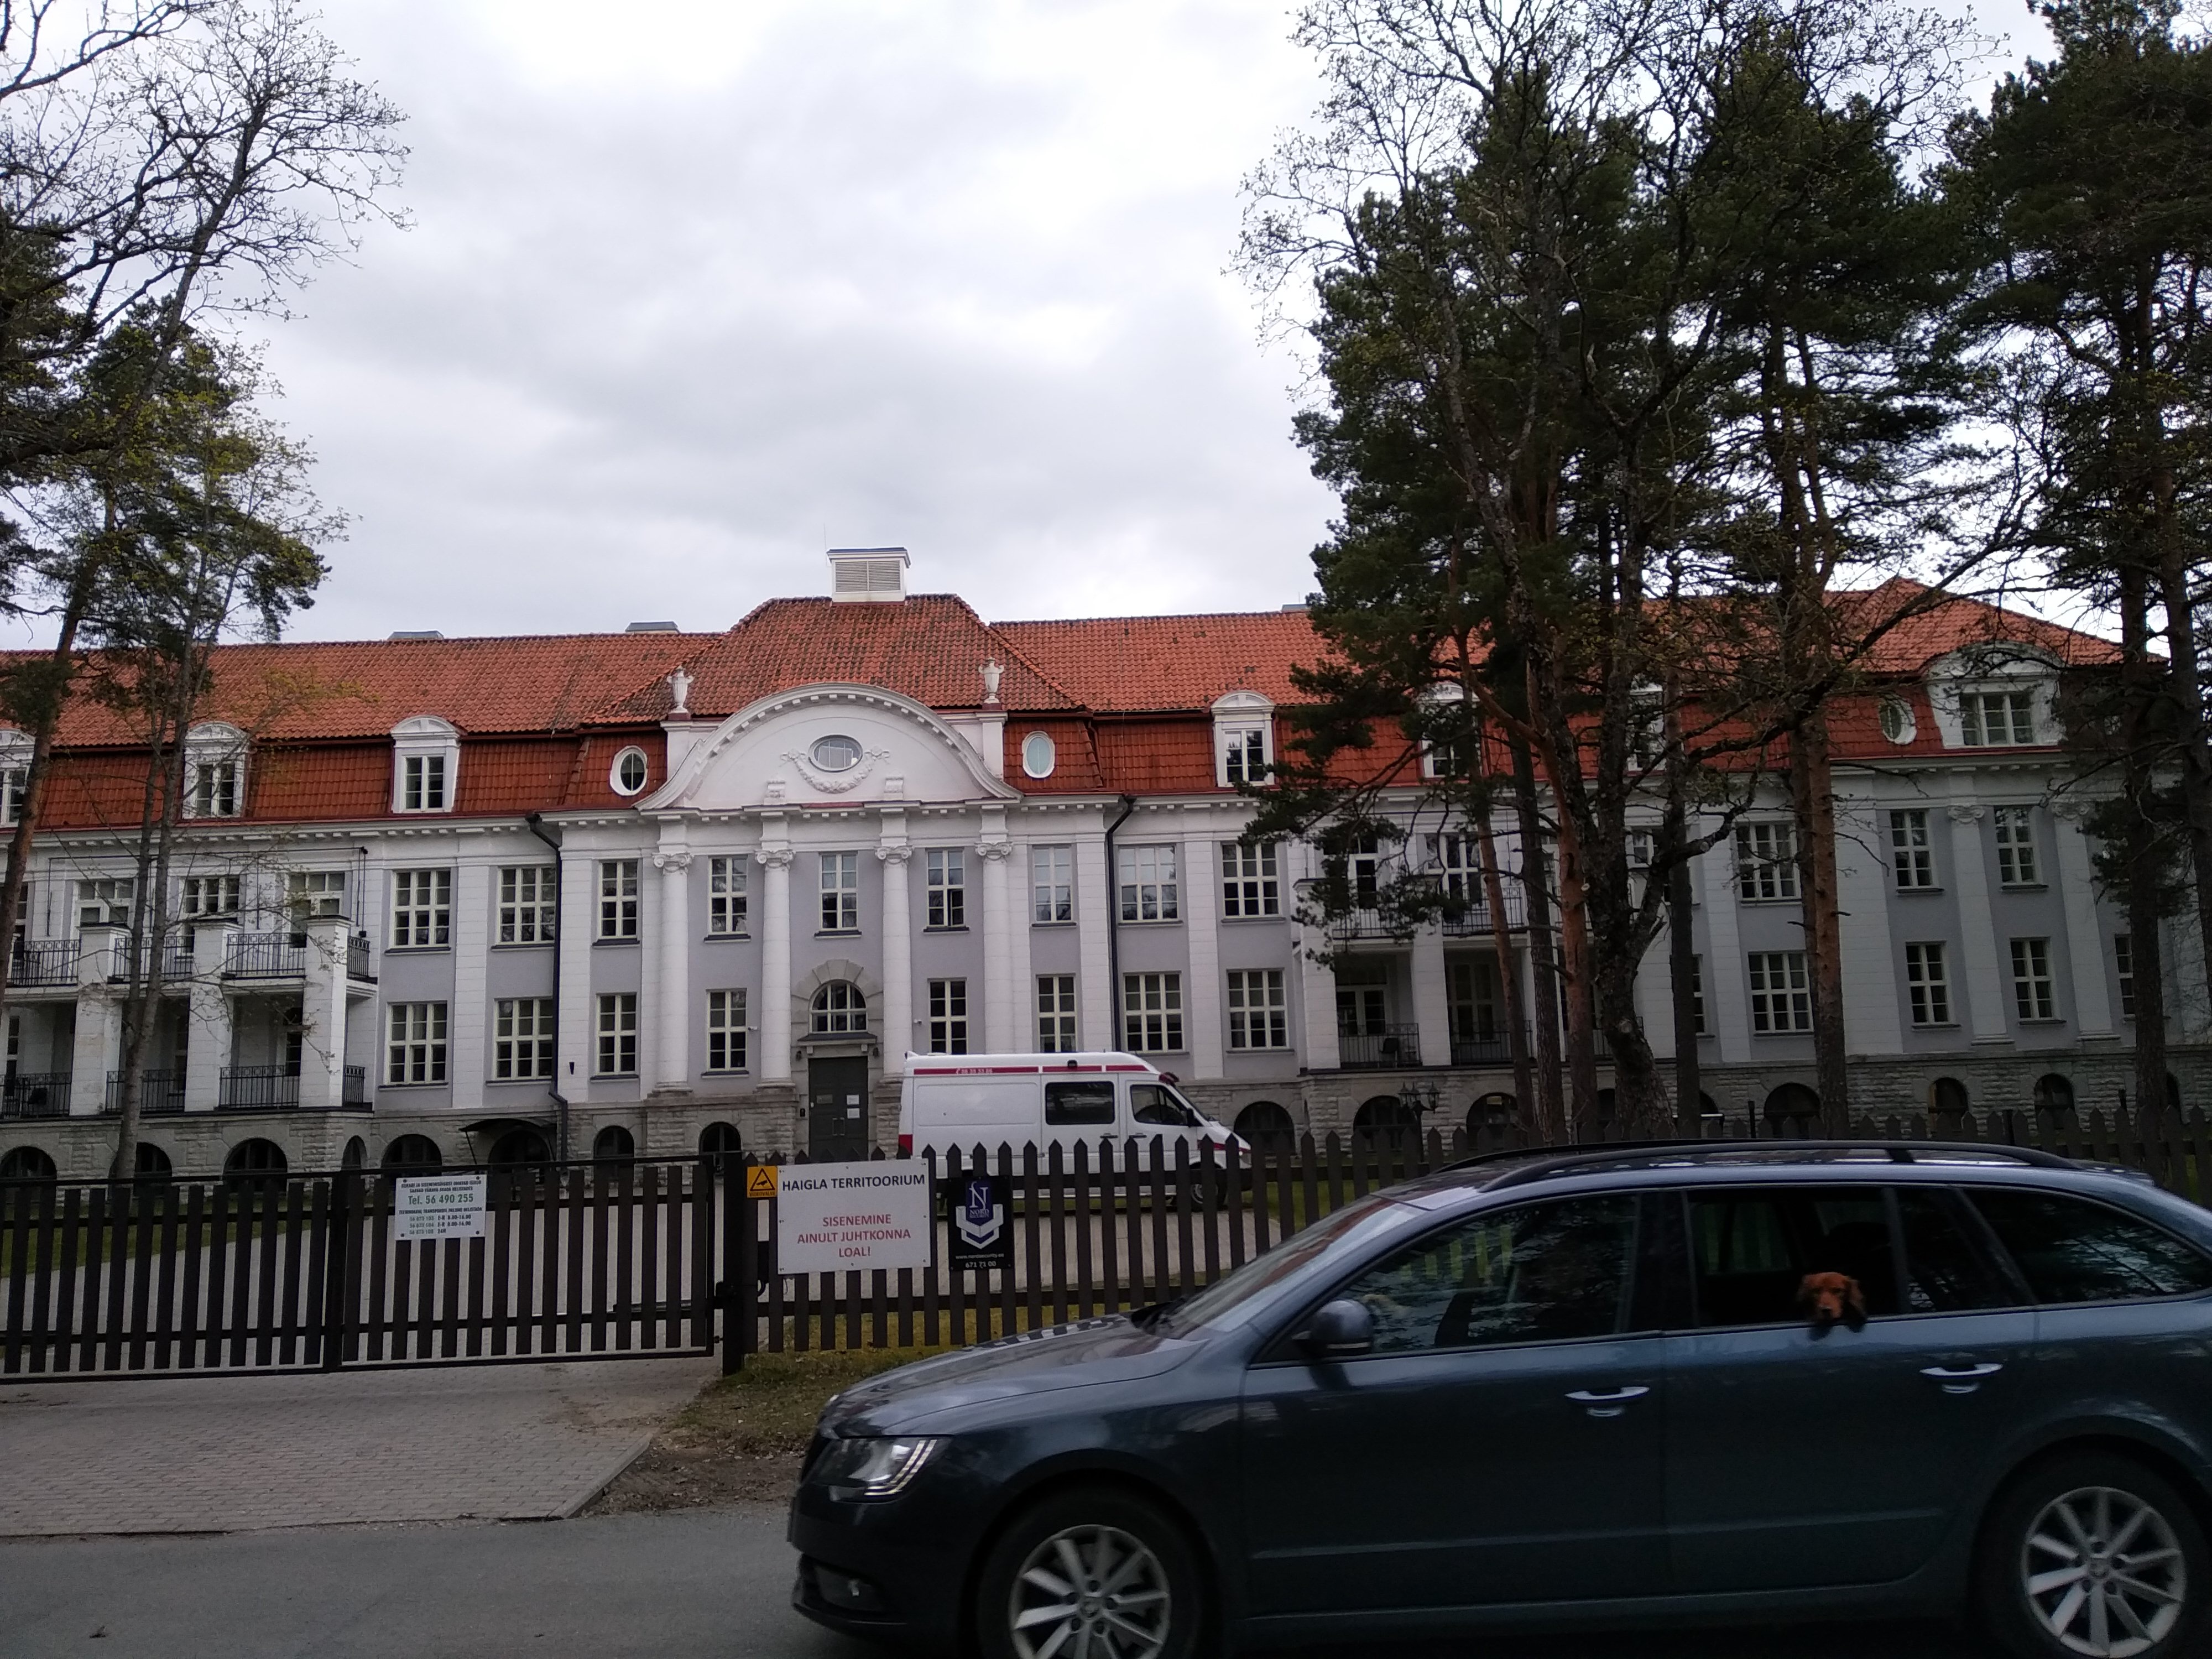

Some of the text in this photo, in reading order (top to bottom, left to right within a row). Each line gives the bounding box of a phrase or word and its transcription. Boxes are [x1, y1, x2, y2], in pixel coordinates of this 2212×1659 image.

[782, 1174, 925, 1192] HAIGLA TERRITOORIUM
[408, 1193, 474, 1205] Tel. 56 490 255
[822, 1214, 891, 1227] SISENEMINE
[797, 1229, 911, 1244] AINULT JUHTKONNA
[838, 1246, 871, 1258] LOAL!
